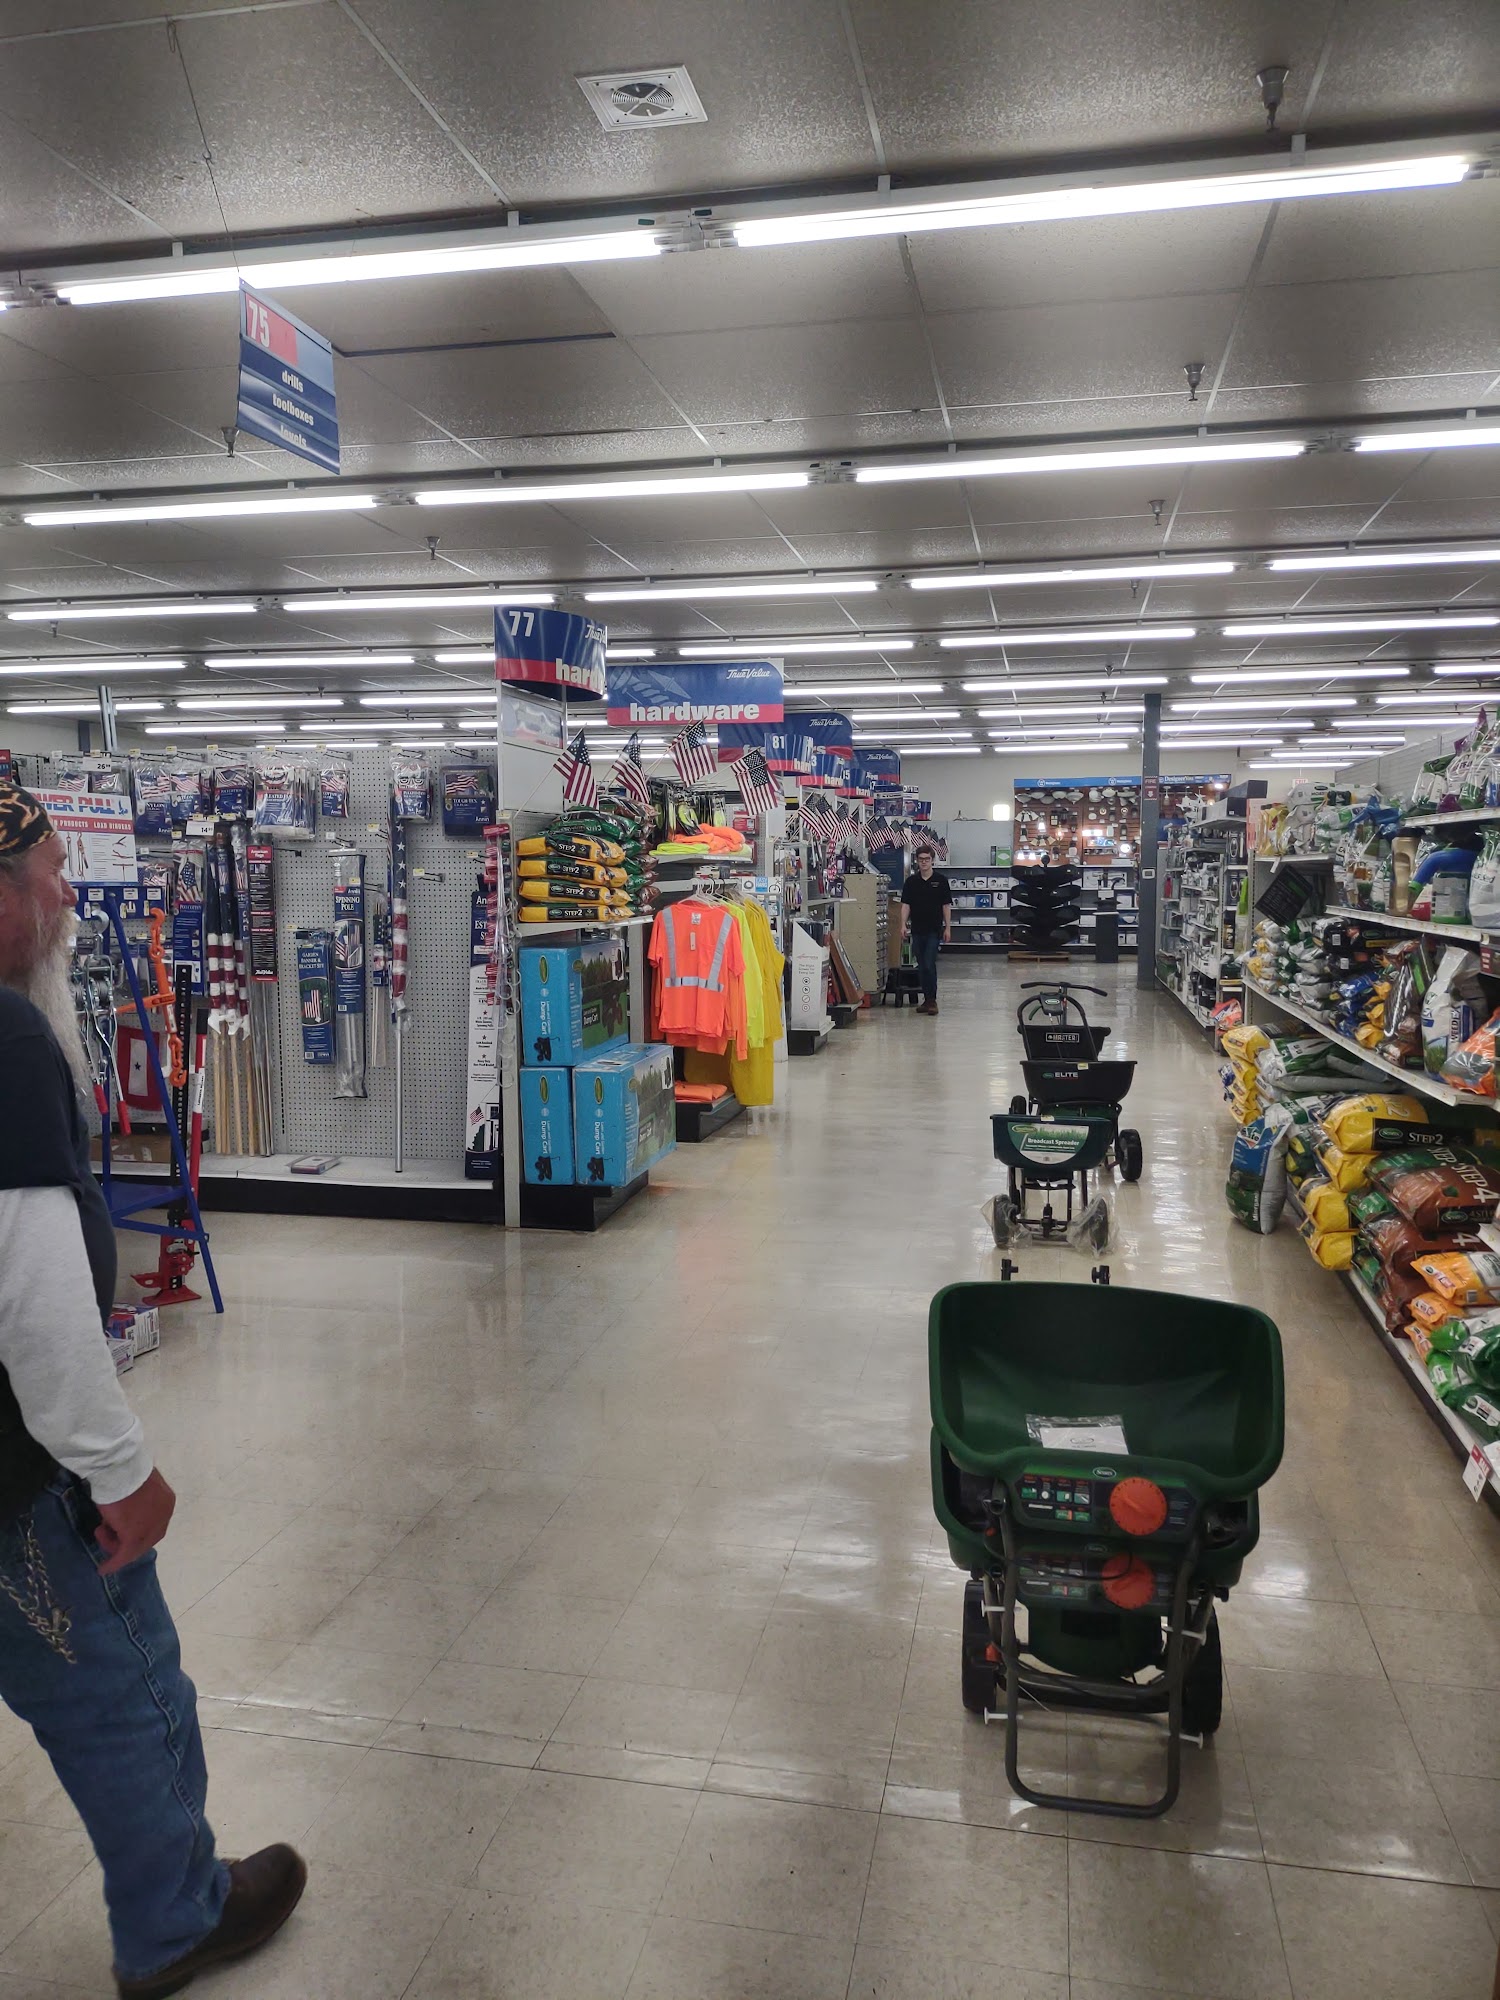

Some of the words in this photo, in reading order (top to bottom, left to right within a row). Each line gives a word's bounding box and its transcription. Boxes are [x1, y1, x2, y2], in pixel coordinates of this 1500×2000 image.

[248, 300, 270, 348] 75
[281, 369, 304, 393] drills
[272, 393, 314, 427] toolboxes
[280, 424, 307, 448] levels
[508, 610, 535, 637] 77
[629, 702, 760, 722] hardware
[772, 735, 785, 749] 81
[78, 796, 115, 815] PULL
[1028, 1137, 1055, 1145] Broadcast
[1451, 1162, 1489, 1188] STEP
[1473, 1187, 1500, 1204] 4
